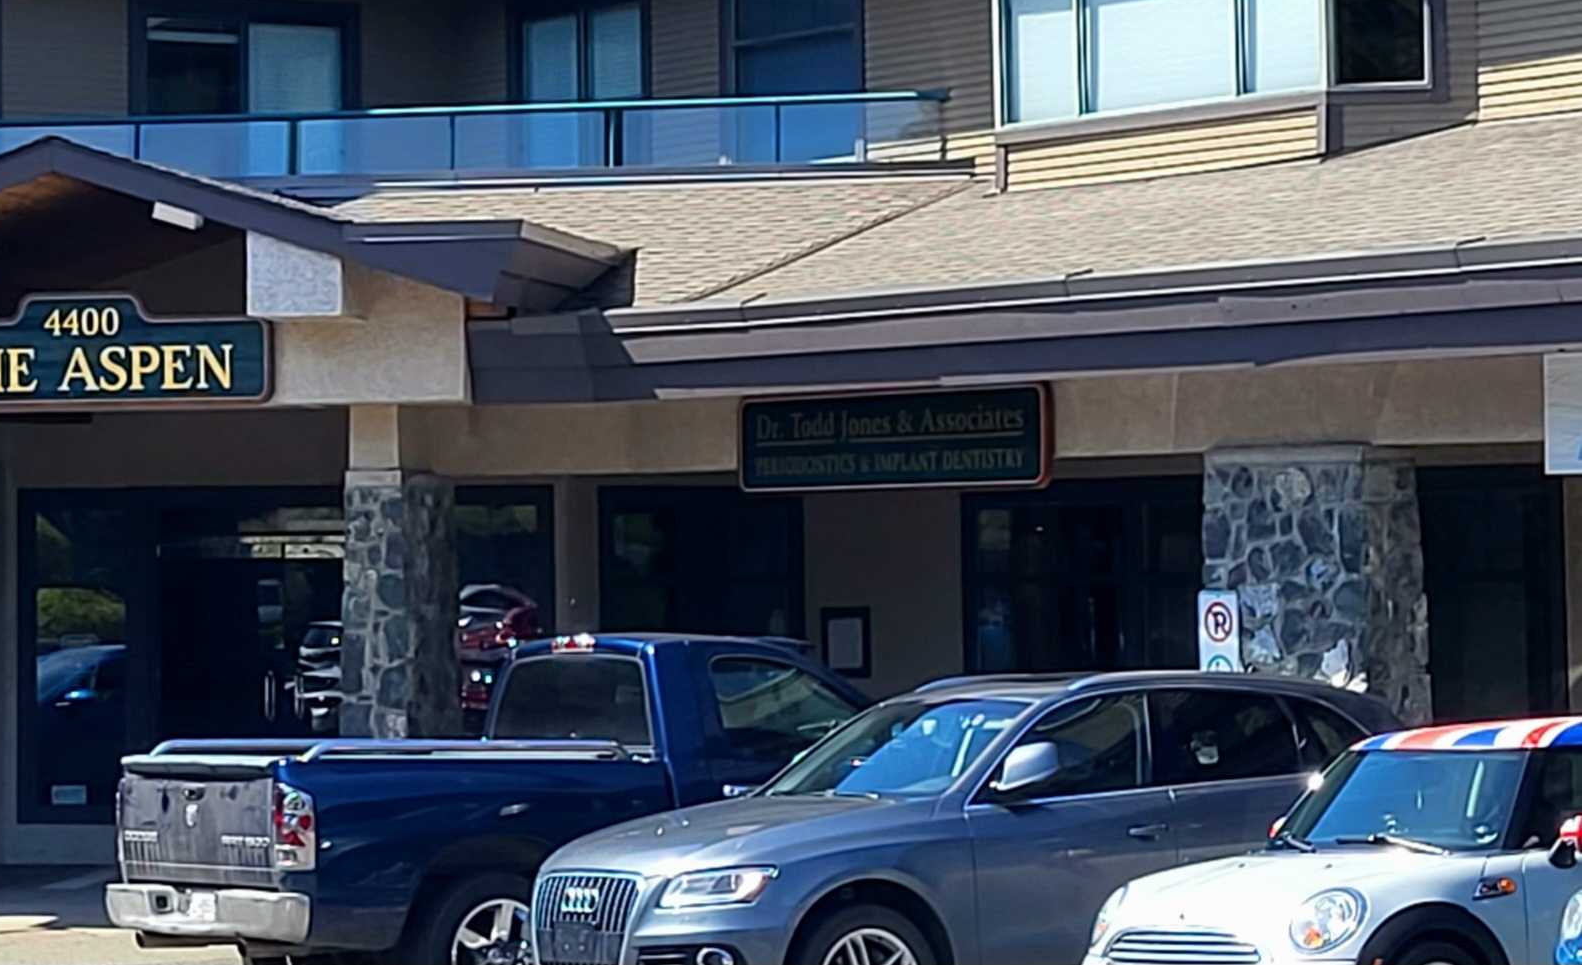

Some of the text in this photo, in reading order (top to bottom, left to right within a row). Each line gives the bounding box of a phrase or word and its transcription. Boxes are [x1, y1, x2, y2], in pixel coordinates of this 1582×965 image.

[43, 307, 119, 337] 4400
[57, 344, 234, 392] ASPEN
[755, 404, 1025, 442] Dr. Todd Jones & Associates
[754, 452, 856, 477] PERIODONTICS
[874, 450, 939, 473] IMPLANT
[942, 448, 1024, 471] DENTISTRY
